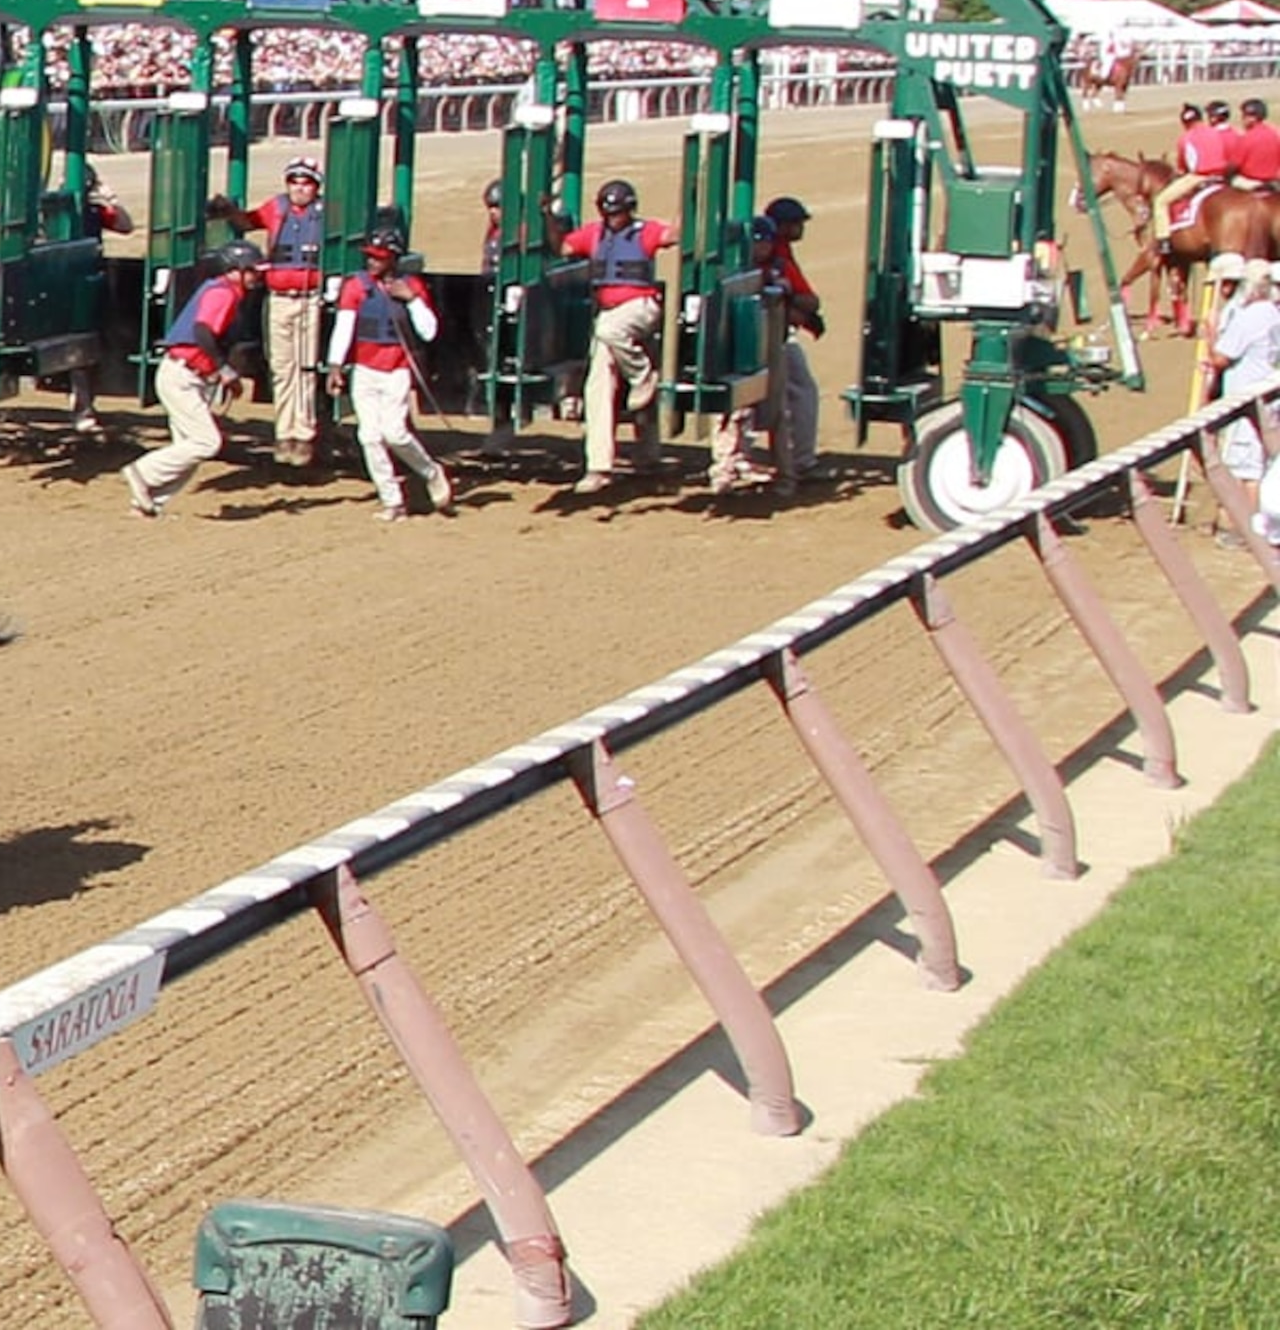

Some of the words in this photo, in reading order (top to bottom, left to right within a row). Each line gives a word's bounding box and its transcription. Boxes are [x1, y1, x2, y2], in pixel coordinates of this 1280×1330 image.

[905, 32, 1038, 62] UNITED
[934, 60, 1038, 90] PUETT
[27, 973, 140, 1069] SARATOGA
